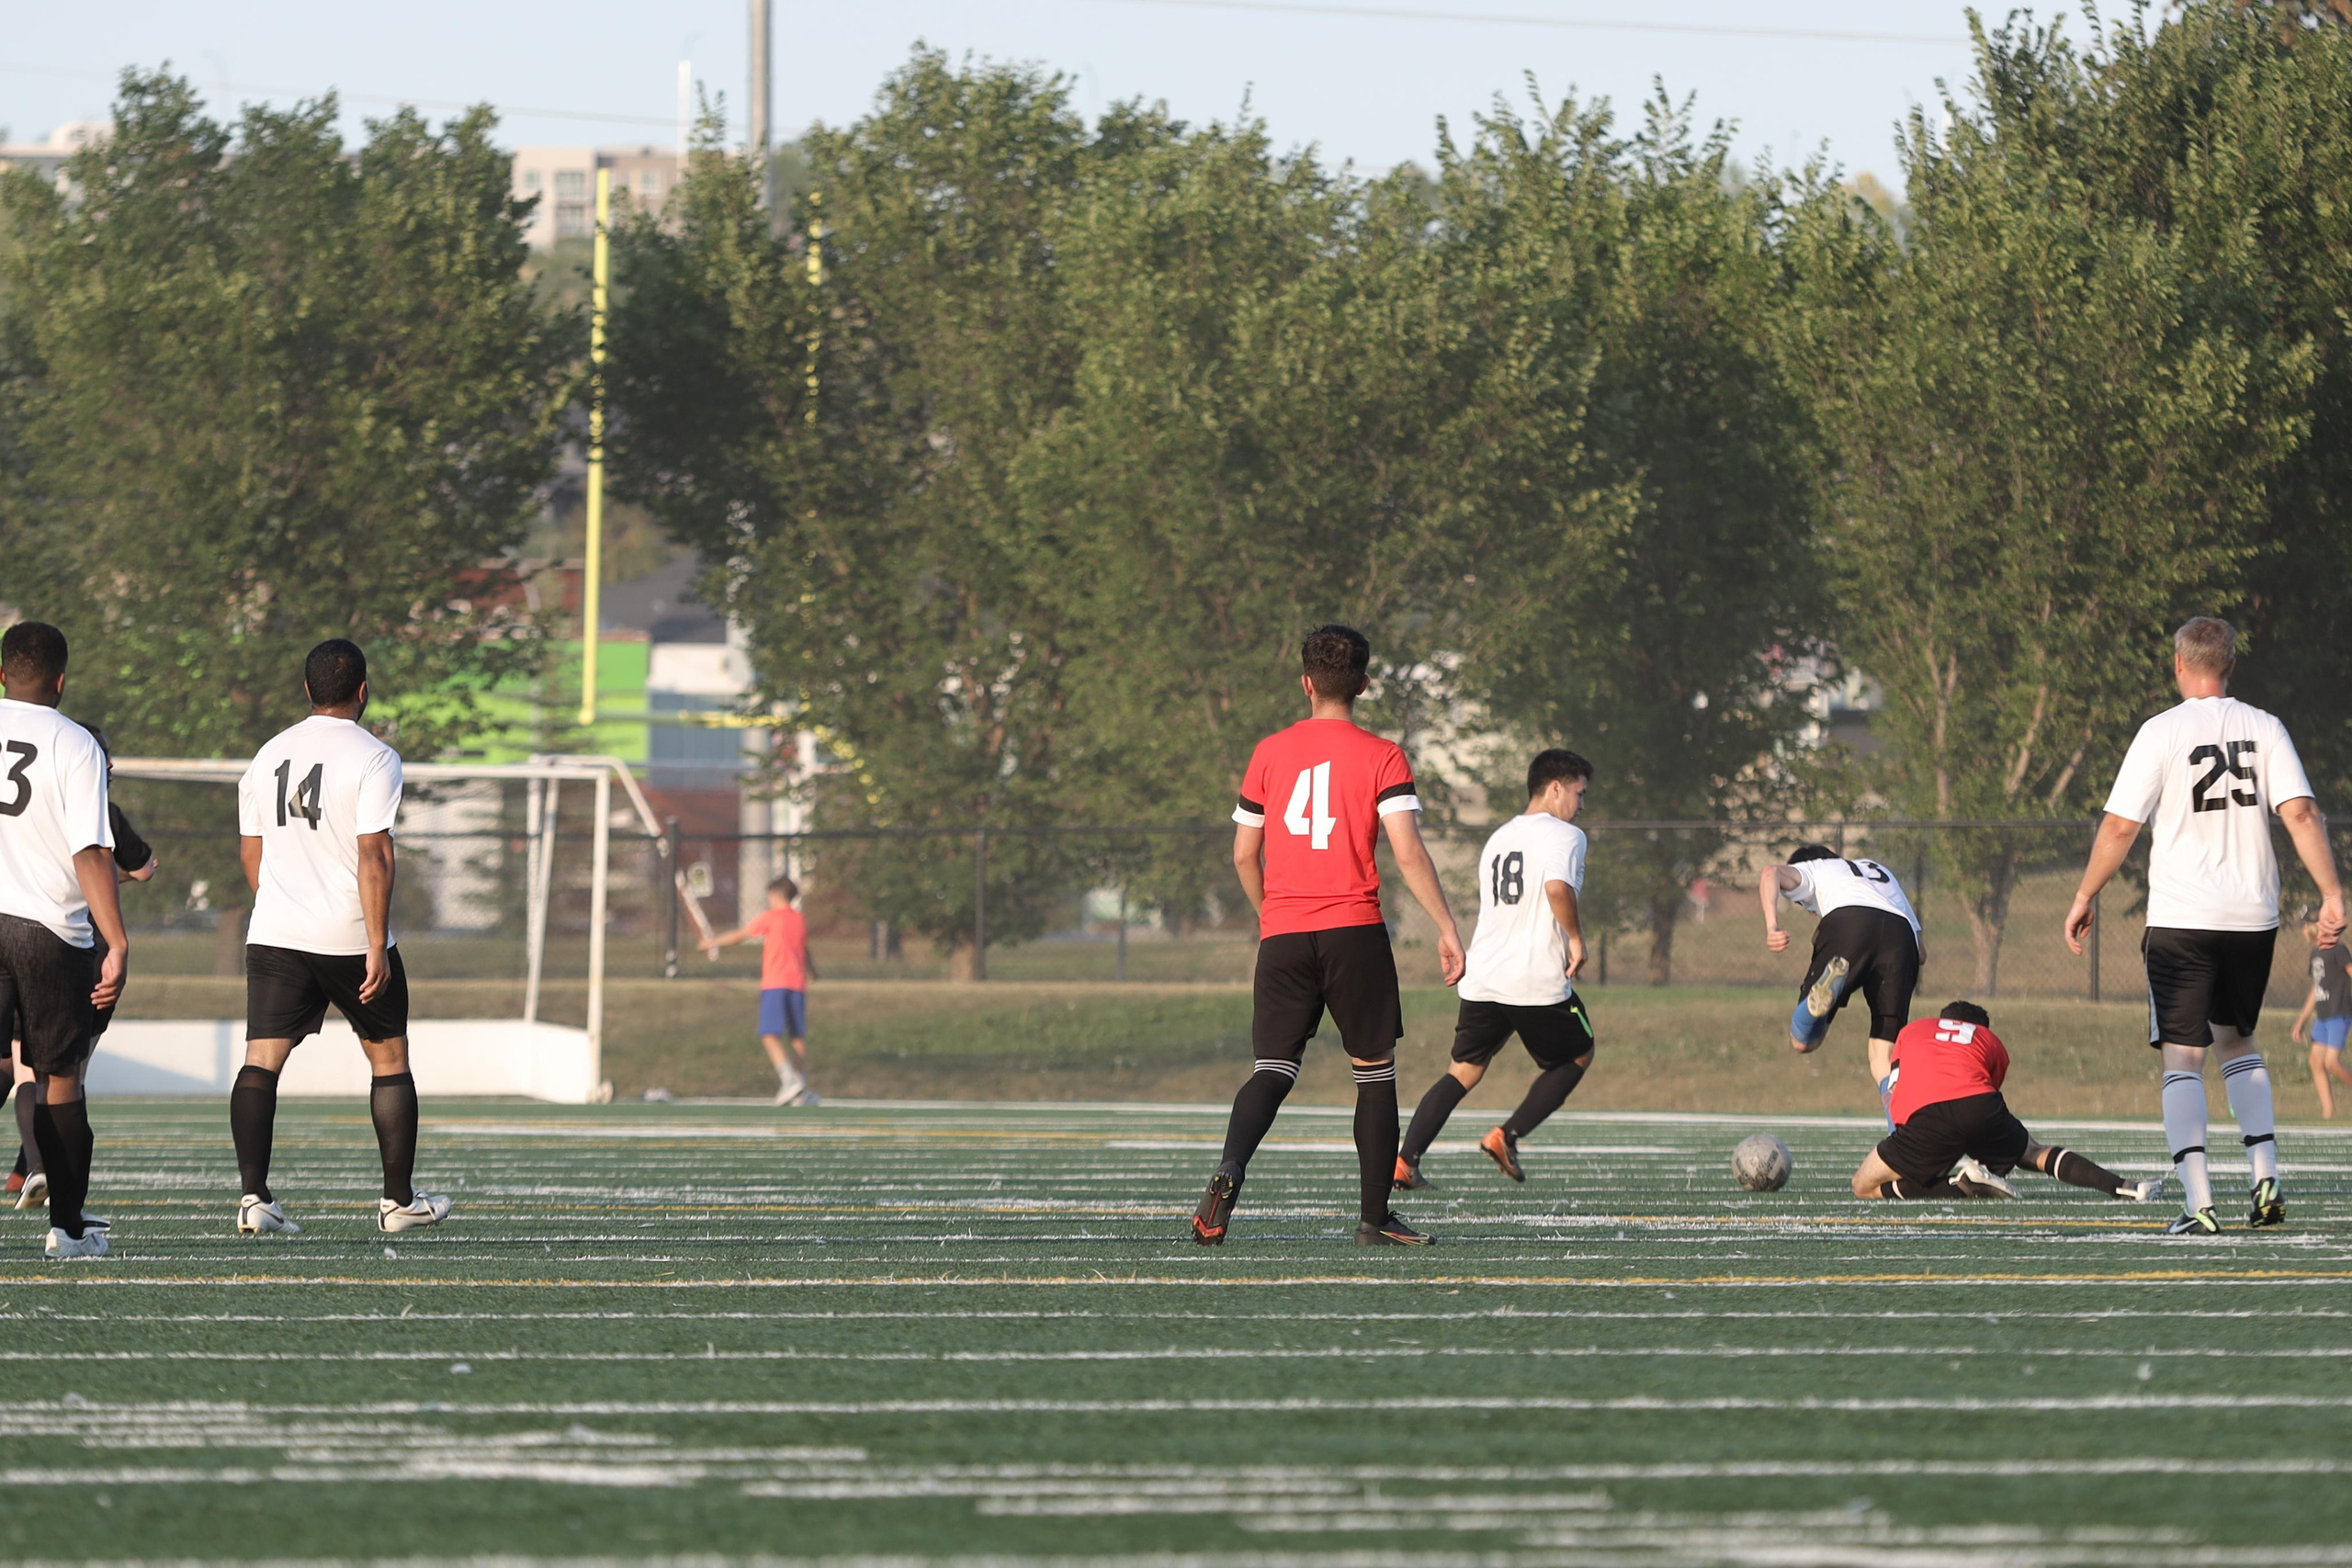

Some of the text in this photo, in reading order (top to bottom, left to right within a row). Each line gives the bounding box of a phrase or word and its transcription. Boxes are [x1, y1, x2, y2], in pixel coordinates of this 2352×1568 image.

[0, 739, 38, 817] 3
[275, 760, 323, 830] 14
[1283, 761, 1336, 850] 4
[2188, 739, 2258, 812] 25
[1492, 852, 1524, 908] 18
[1845, 860, 1890, 884] 13
